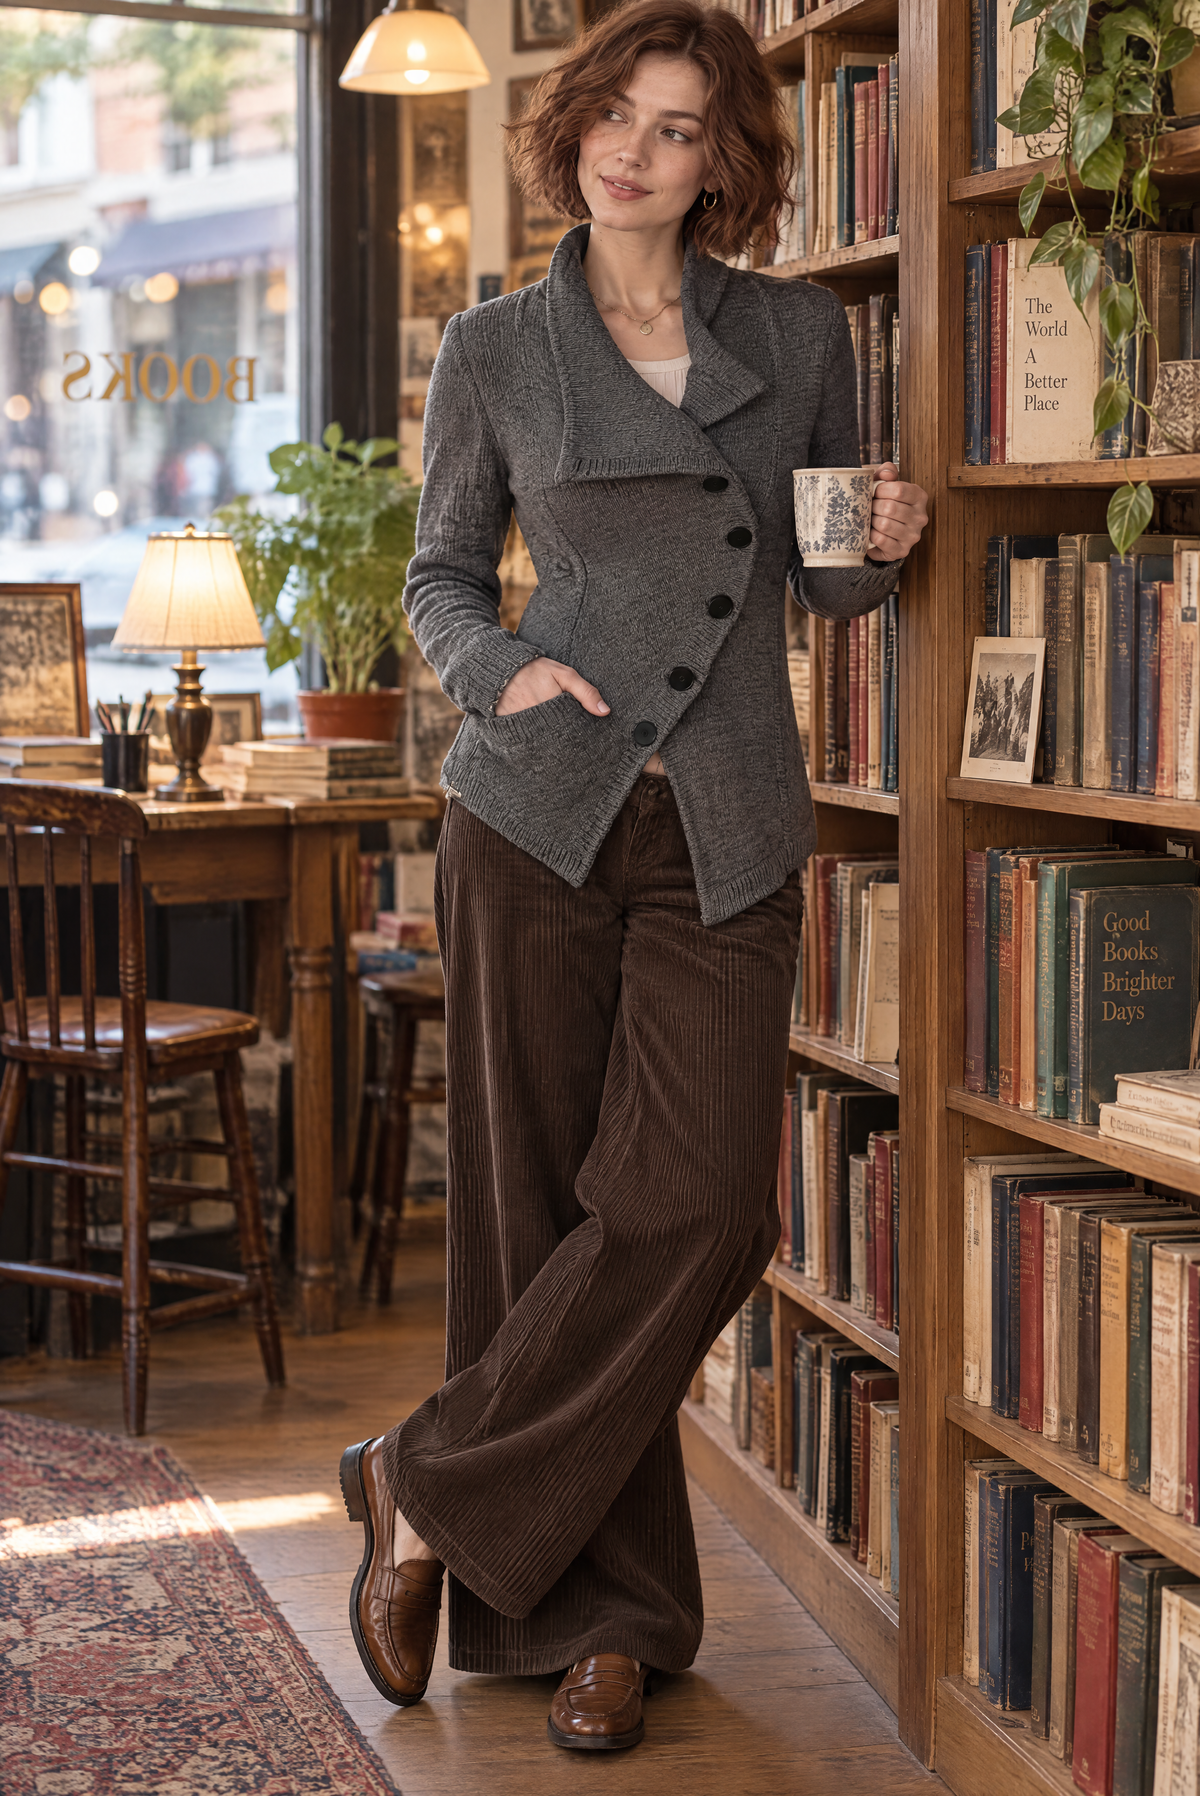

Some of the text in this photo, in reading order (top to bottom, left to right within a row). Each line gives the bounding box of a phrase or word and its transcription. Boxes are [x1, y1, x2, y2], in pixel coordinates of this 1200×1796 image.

[1024, 297, 1053, 314] The
[1025, 320, 1068, 337] World
[1024, 348, 1037, 364] A
[1024, 372, 1068, 389] Better
[1024, 394, 1059, 411] Place
[1103, 910, 1151, 932] Good
[1102, 939, 1159, 962] Books
[1102, 969, 1175, 998] Brighter
[1101, 1000, 1145, 1026] Days
